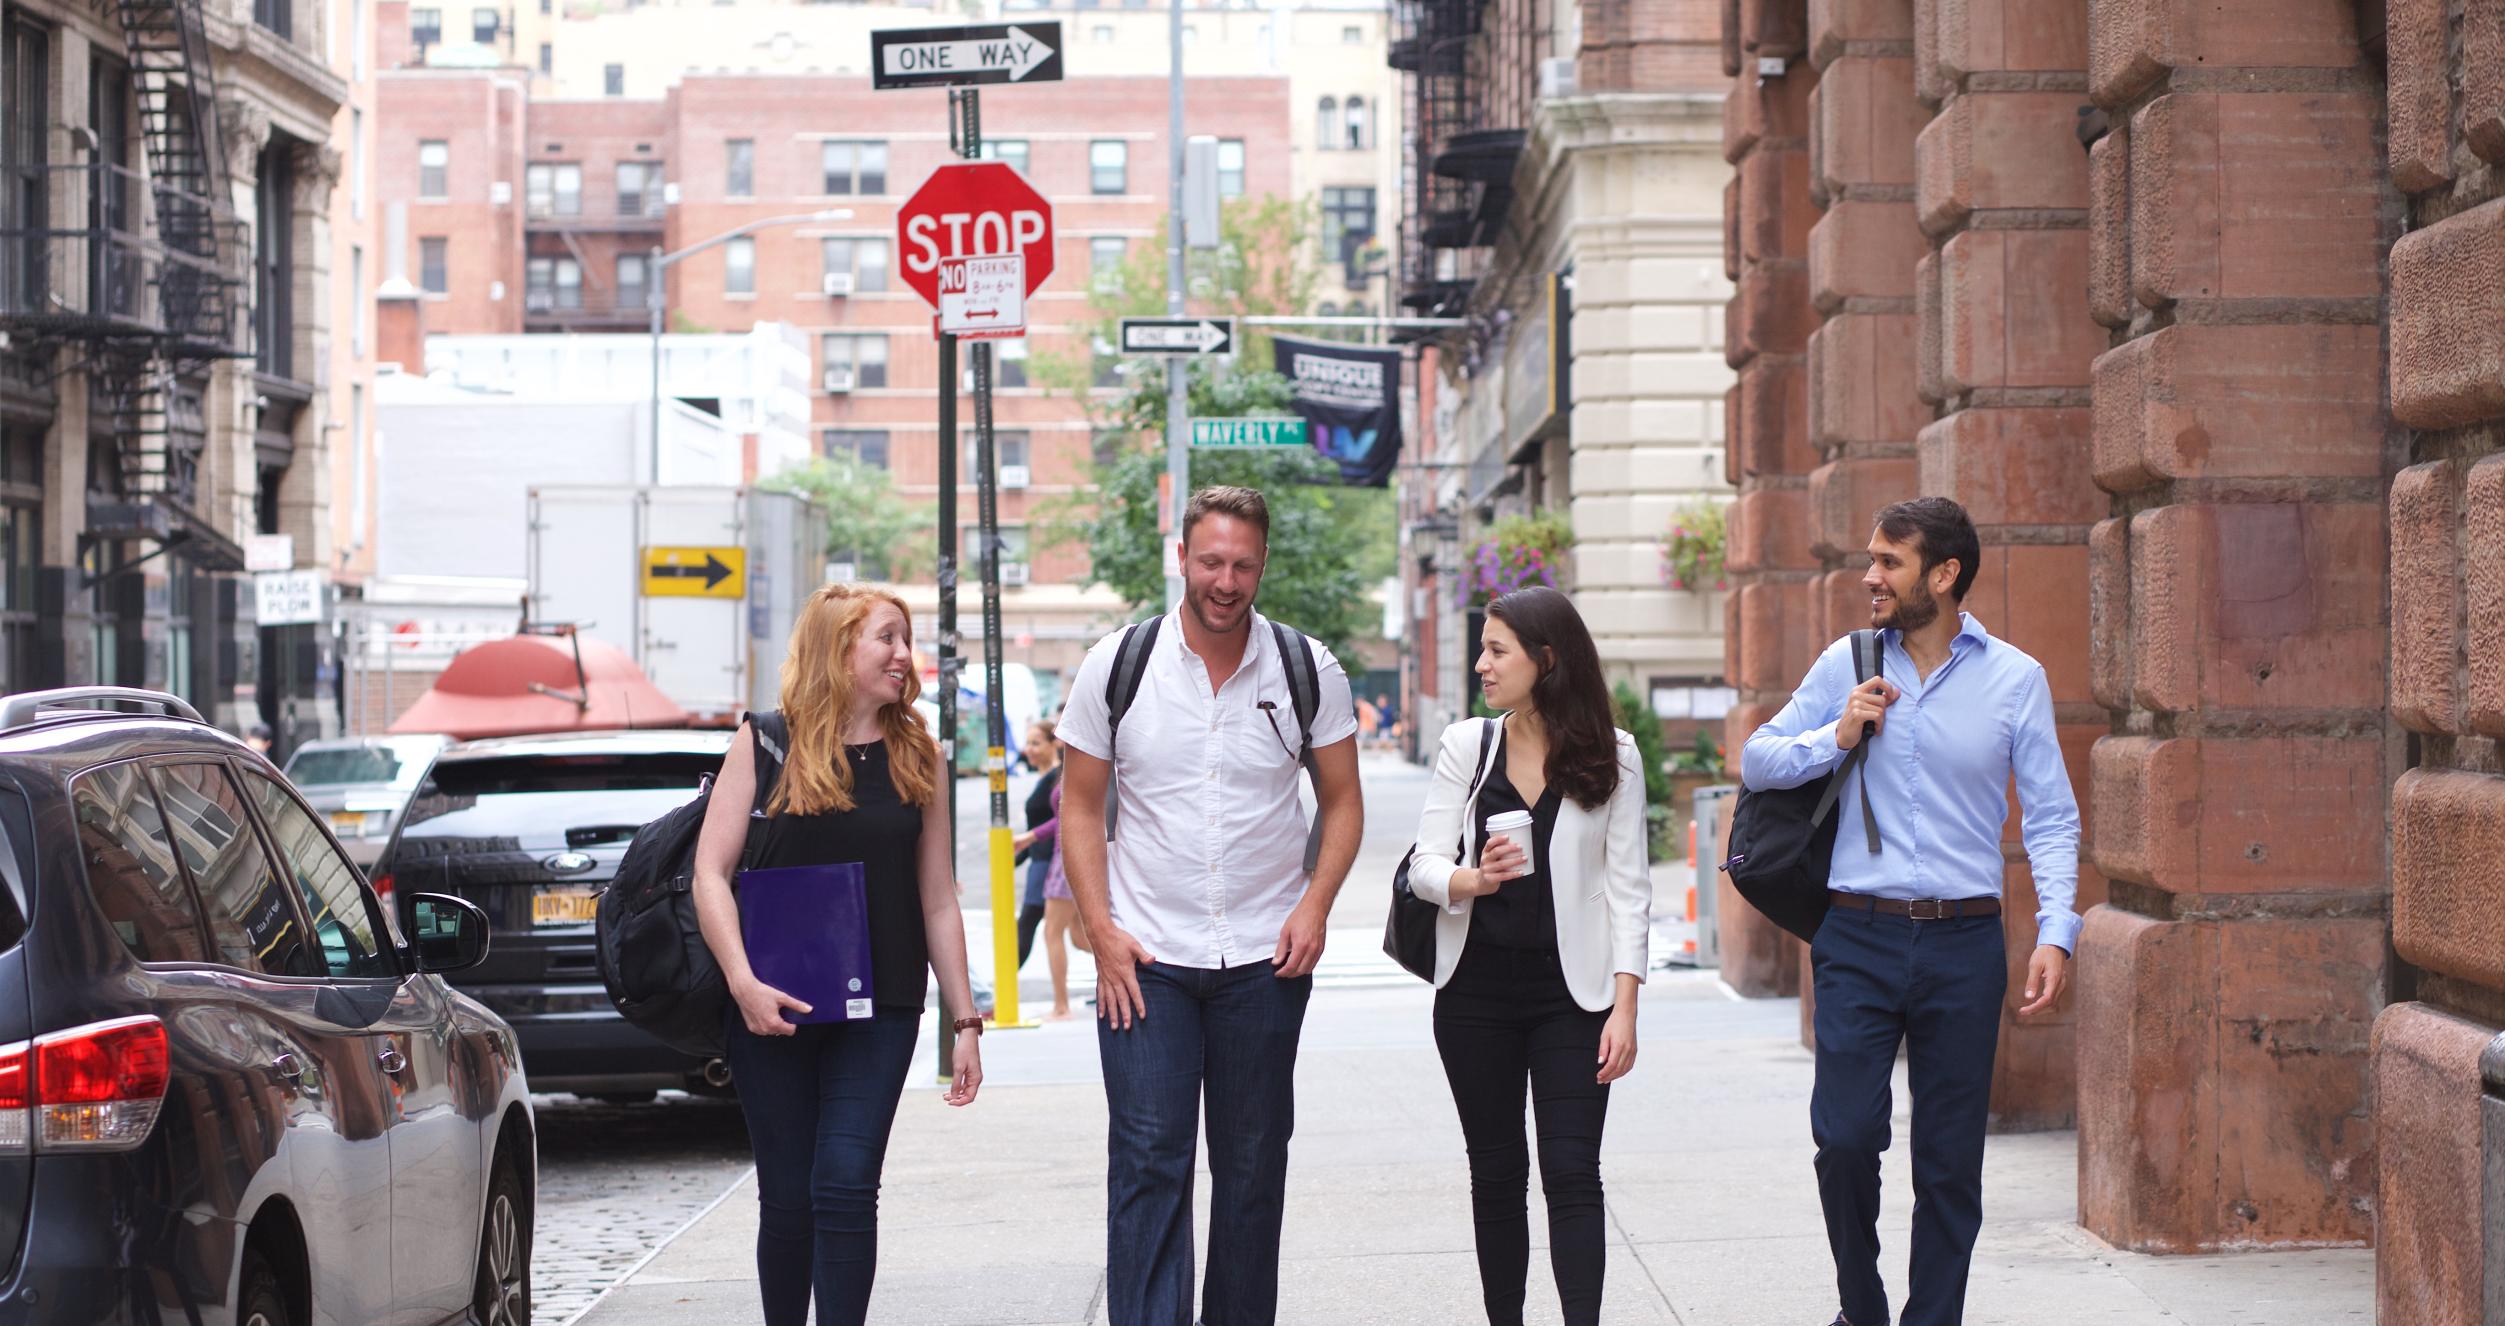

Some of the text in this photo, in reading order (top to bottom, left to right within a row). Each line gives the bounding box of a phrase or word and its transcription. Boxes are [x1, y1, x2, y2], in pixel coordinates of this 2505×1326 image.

[899, 42, 1033, 71] ONE WAY
[906, 210, 1046, 273] STOP
[942, 261, 1016, 290] NO PARKING
[1136, 327, 1214, 343] ONE WAY
[1294, 356, 1383, 389] UNIQUE
[1195, 421, 1280, 444] WAVERLY
[264, 579, 309, 596] RAISE
[267, 599, 310, 614] PLOW
